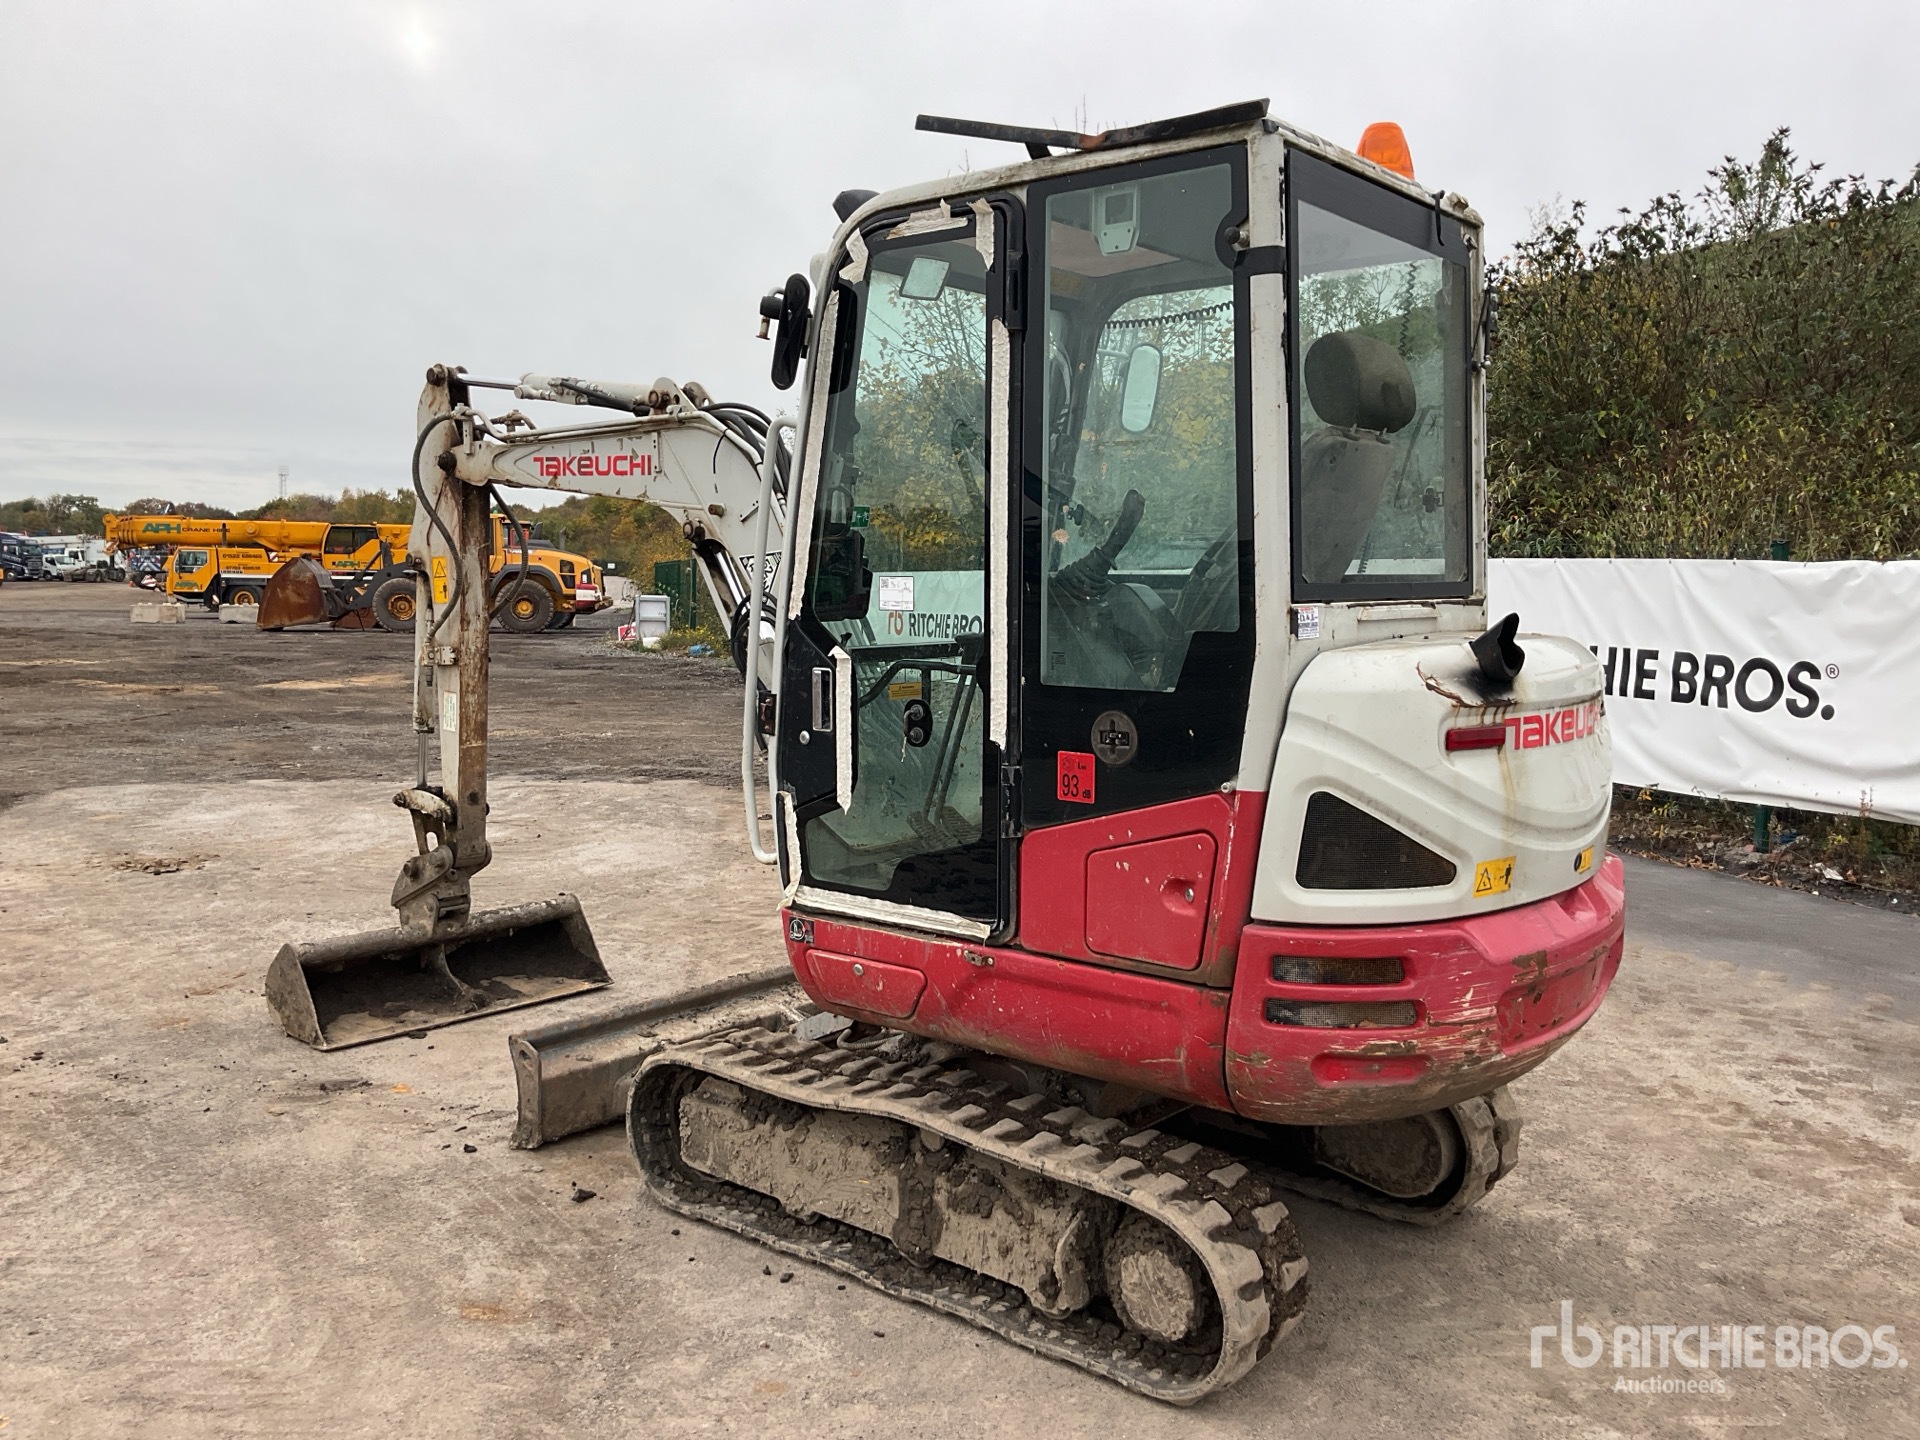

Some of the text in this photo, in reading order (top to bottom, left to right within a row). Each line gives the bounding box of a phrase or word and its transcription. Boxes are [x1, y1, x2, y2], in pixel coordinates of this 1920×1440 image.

[533, 455, 651, 476] TAKEUCHI
[909, 613, 951, 639] RITCHIE
[1062, 773, 1080, 797] 93
